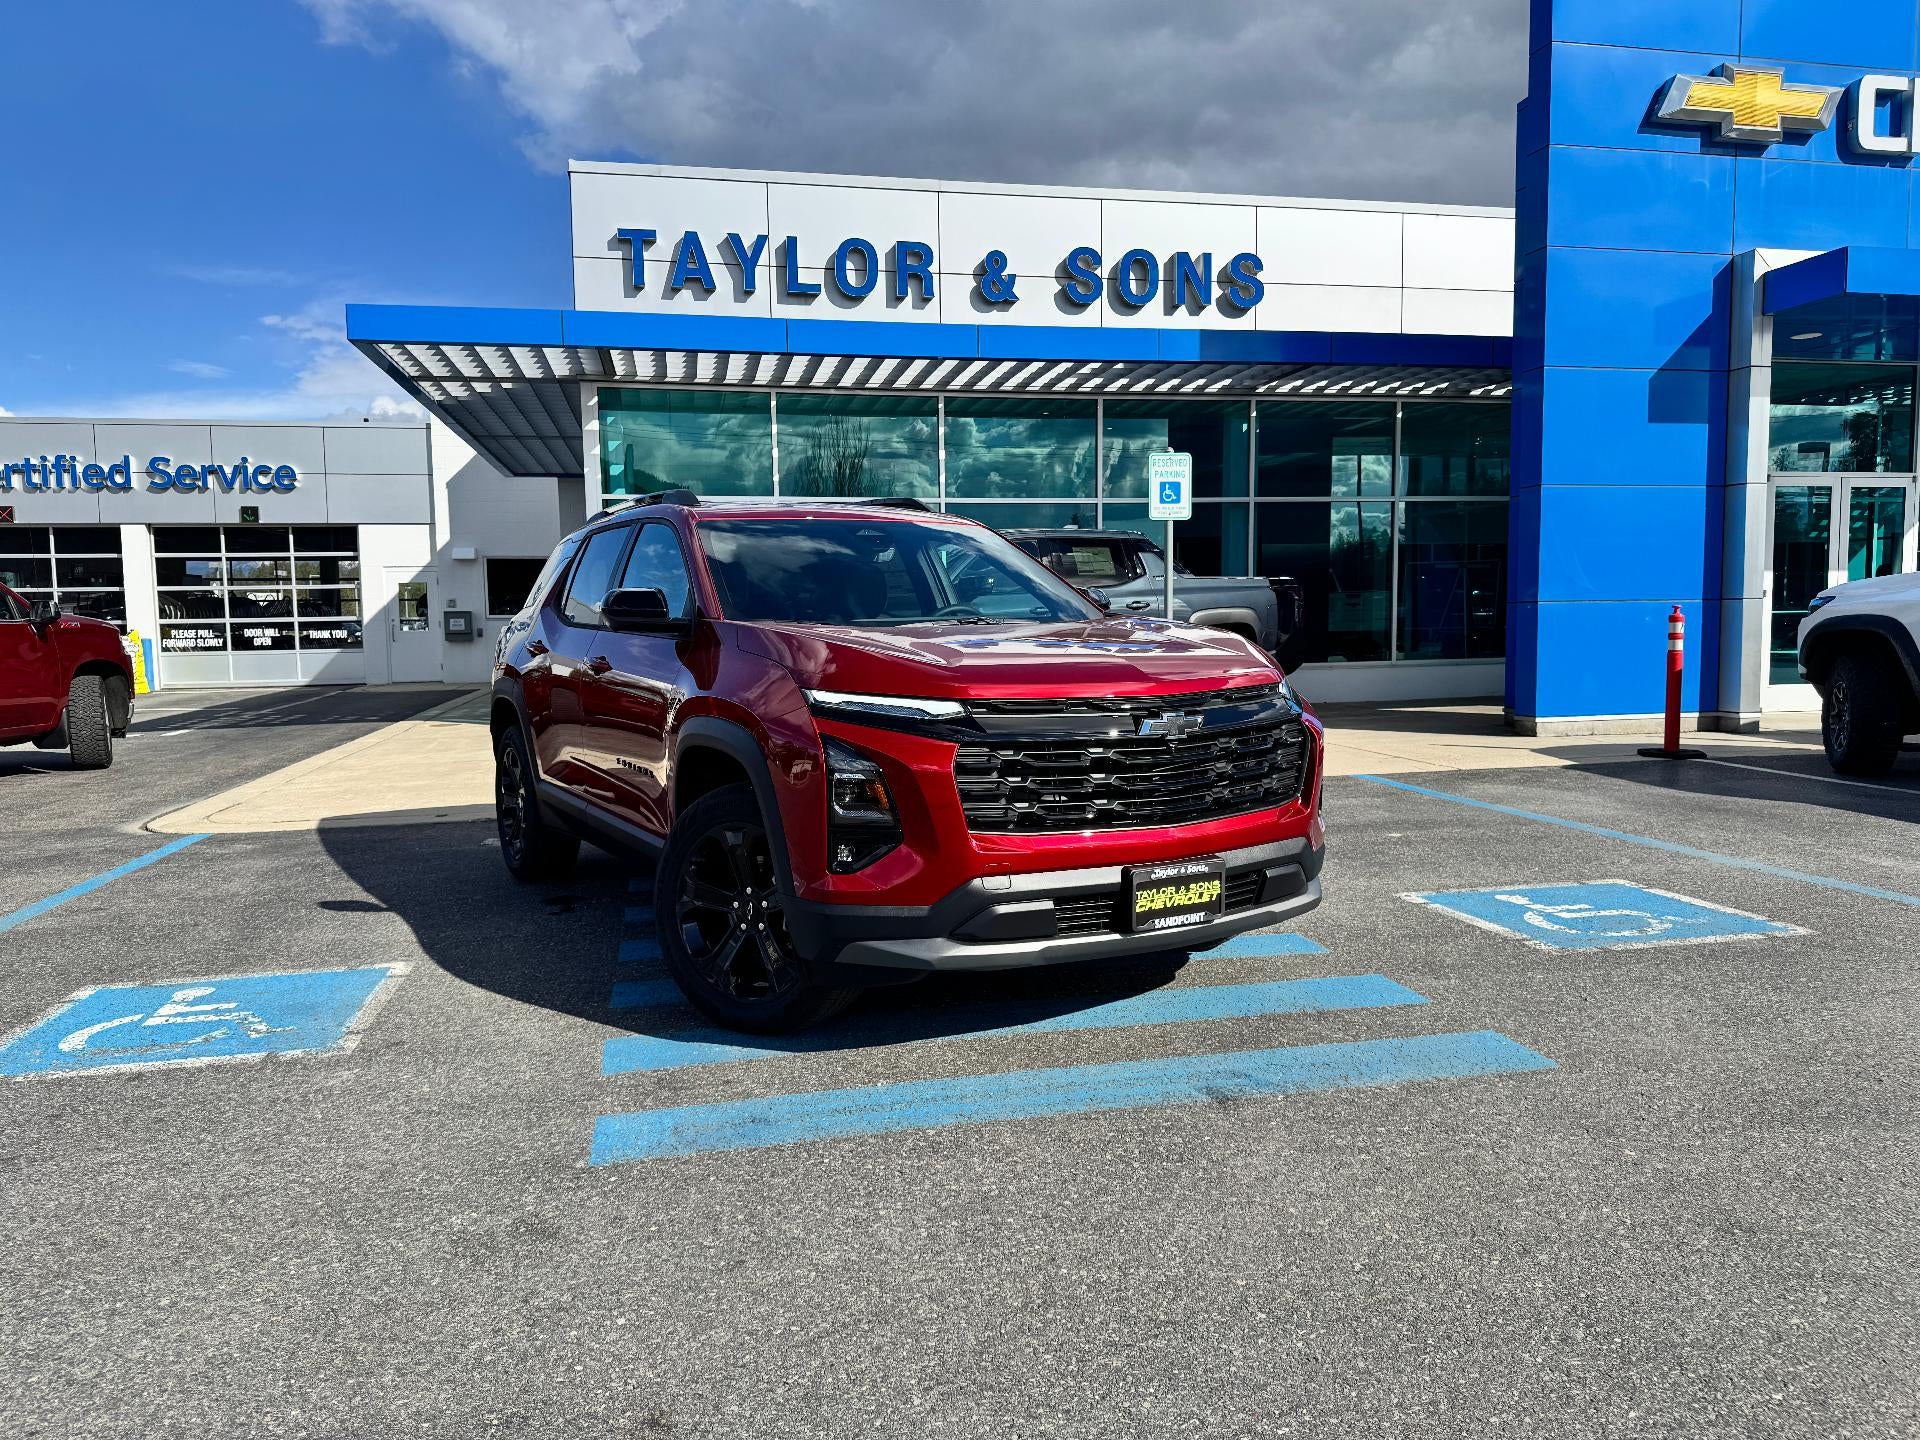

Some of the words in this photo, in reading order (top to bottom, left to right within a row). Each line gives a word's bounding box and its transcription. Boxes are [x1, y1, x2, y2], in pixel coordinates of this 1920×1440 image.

[616, 227, 936, 300] TAYLOR
[979, 248, 1020, 303] &
[1065, 246, 1265, 309] SONS
[1152, 458, 1187, 468] RESERVED
[149, 455, 297, 490] Service
[1154, 470, 1186, 479] PARKING
[171, 629, 197, 638] PLEASE
[197, 629, 215, 638] PULL
[244, 628, 263, 637] DOOR
[263, 628, 281, 637] WILL
[309, 630, 331, 639] THANK
[331, 629, 348, 638] YOU!
[162, 638, 196, 648] FORWARD
[196, 638, 223, 647] SLOWLY
[253, 637, 272, 646] OPEN
[1152, 867, 1179, 880] Taylor
[1187, 864, 1205, 874] Sons
[1135, 886, 1176, 901] TAYLOR
[1179, 885, 1188, 895] &
[1189, 880, 1221, 894] SONS
[1135, 891, 1220, 913] CHEVROLET
[1154, 911, 1206, 929] SANDPOINT
